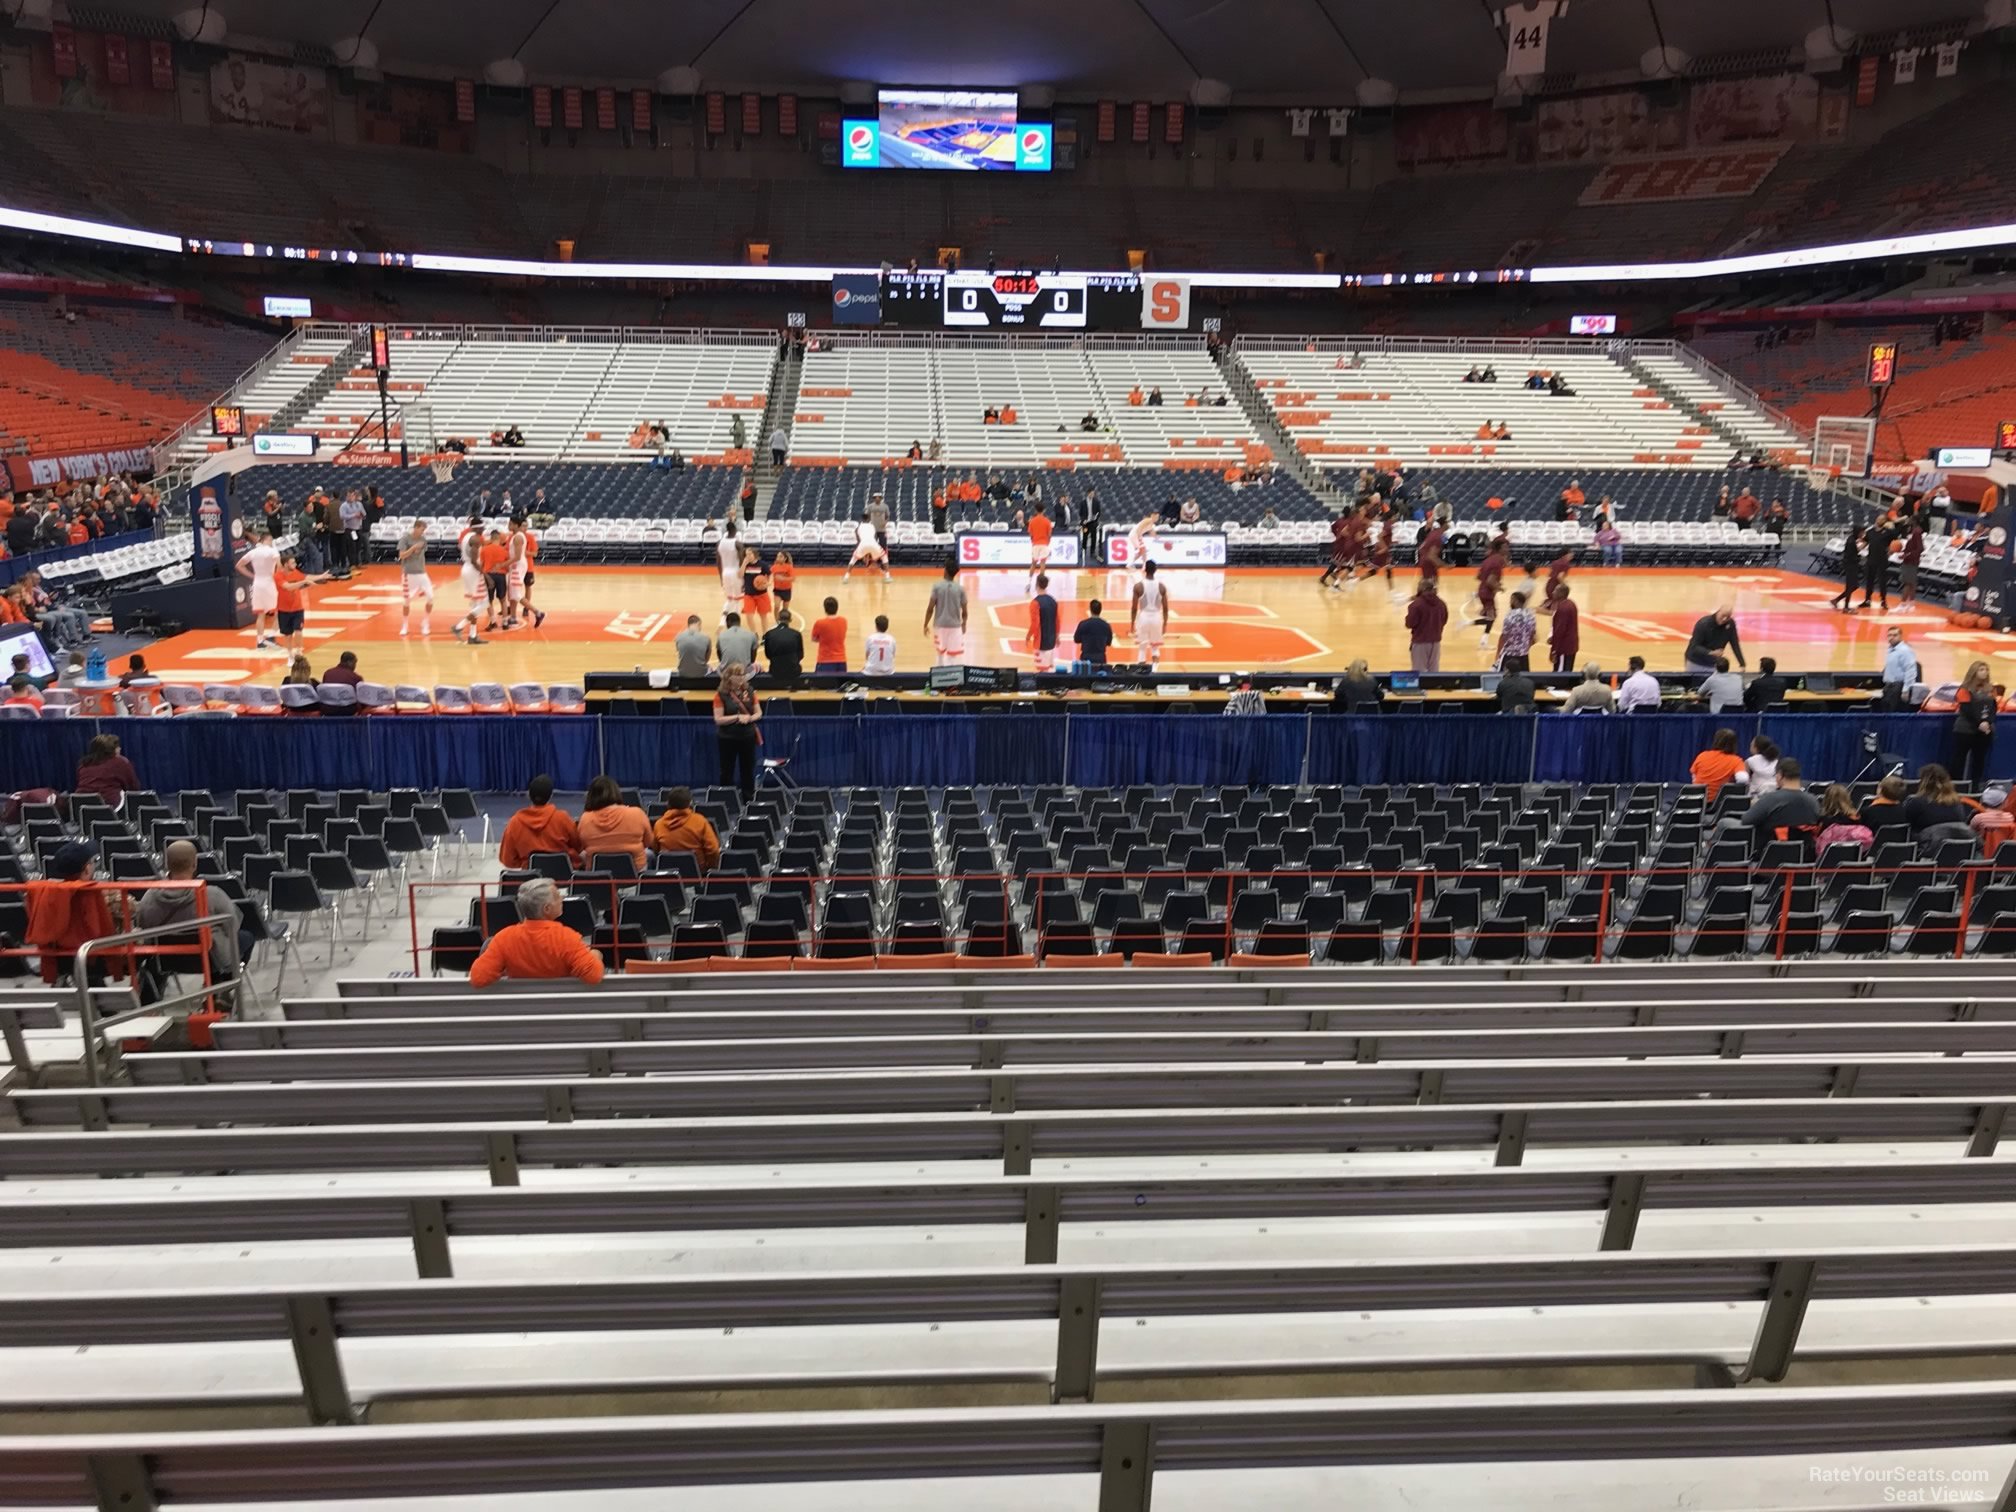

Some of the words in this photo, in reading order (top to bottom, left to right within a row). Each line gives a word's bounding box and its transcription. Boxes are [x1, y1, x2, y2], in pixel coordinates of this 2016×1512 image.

[1513, 24, 1542, 50] 44
[995, 278, 1038, 293] 50:12
[851, 293, 878, 304] pepsi
[962, 289, 977, 311] 0
[1053, 291, 1069, 312] 0
[1151, 281, 1181, 322] S
[1872, 360, 1891, 382] 30
[28, 458, 61, 485] NEW
[59, 452, 109, 481] YORK'S
[962, 538, 980, 561] S
[1111, 538, 1128, 561] S
[879, 647, 885, 661] 1
